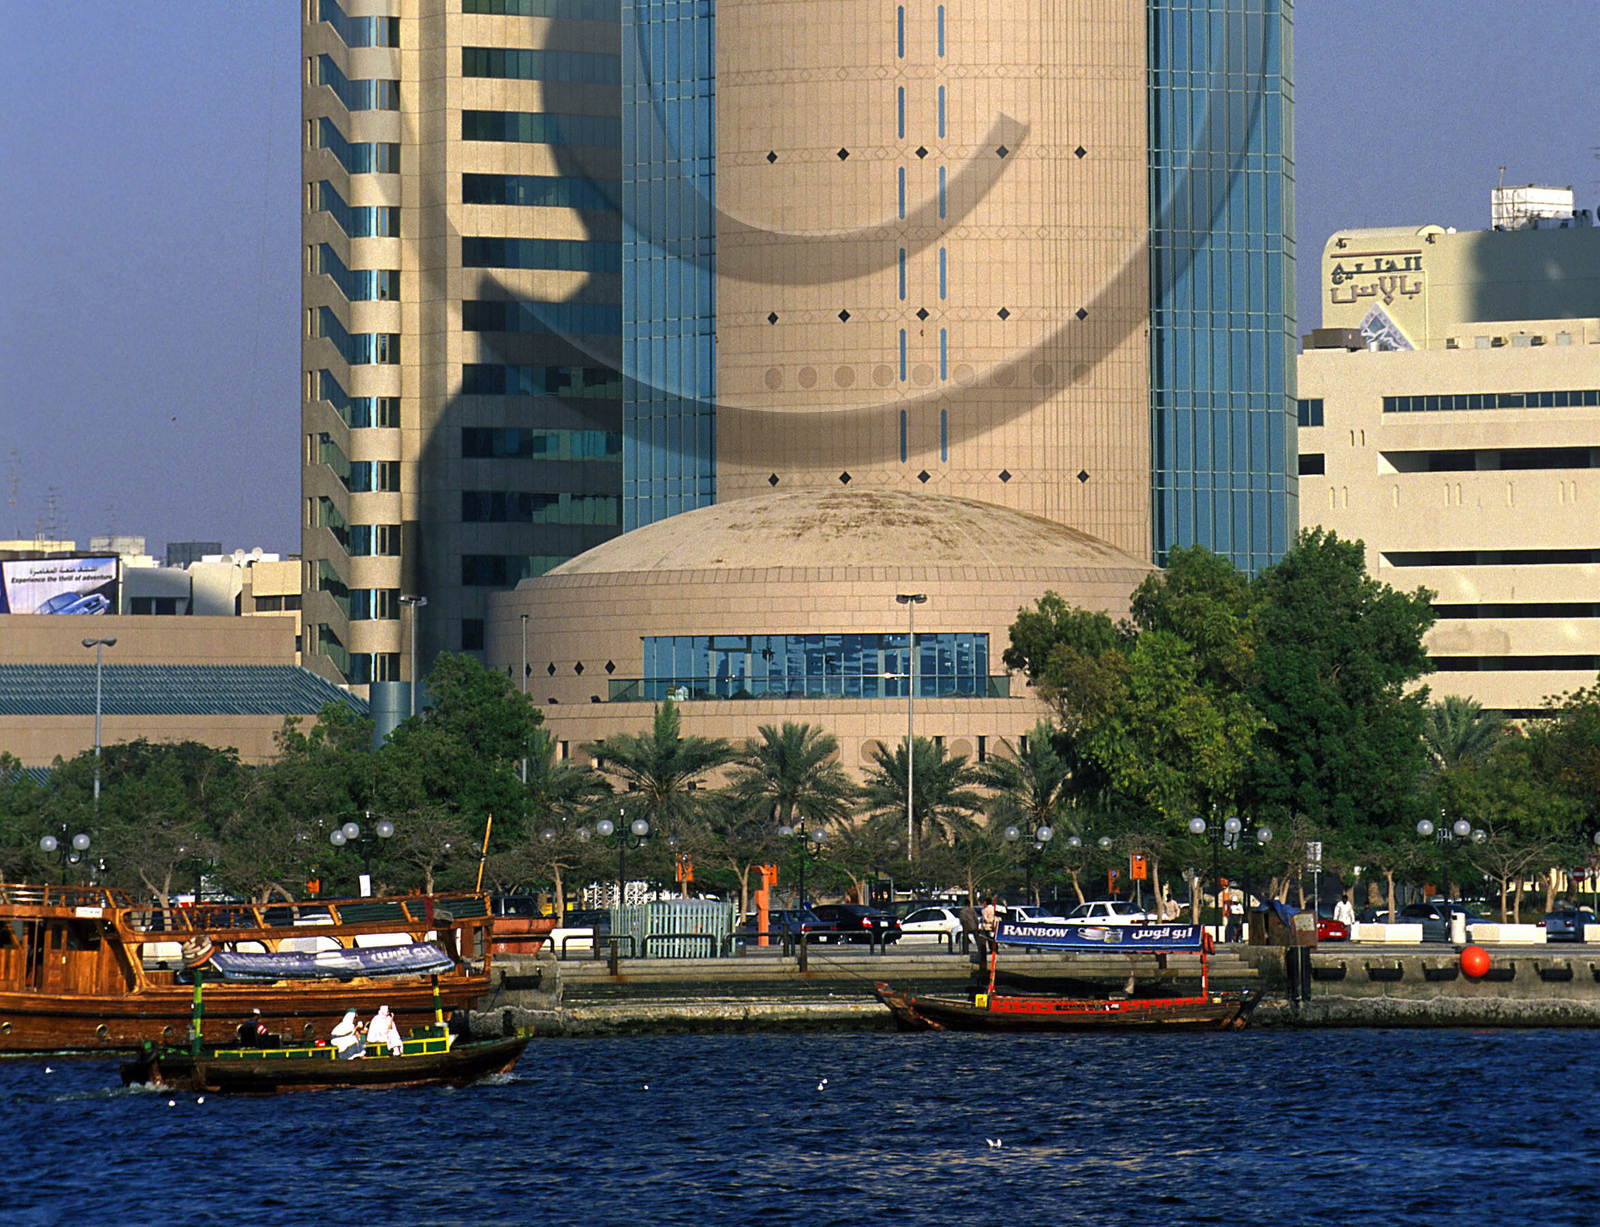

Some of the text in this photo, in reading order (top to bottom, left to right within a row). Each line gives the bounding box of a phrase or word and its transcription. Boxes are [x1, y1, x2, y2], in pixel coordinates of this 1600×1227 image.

[1331, 256, 1423, 285] الخليج
[1330, 275, 1423, 306] بالاس
[11, 574, 113, 584] Experience the thrill of adventure
[1003, 924, 1069, 938] RAINBOW
